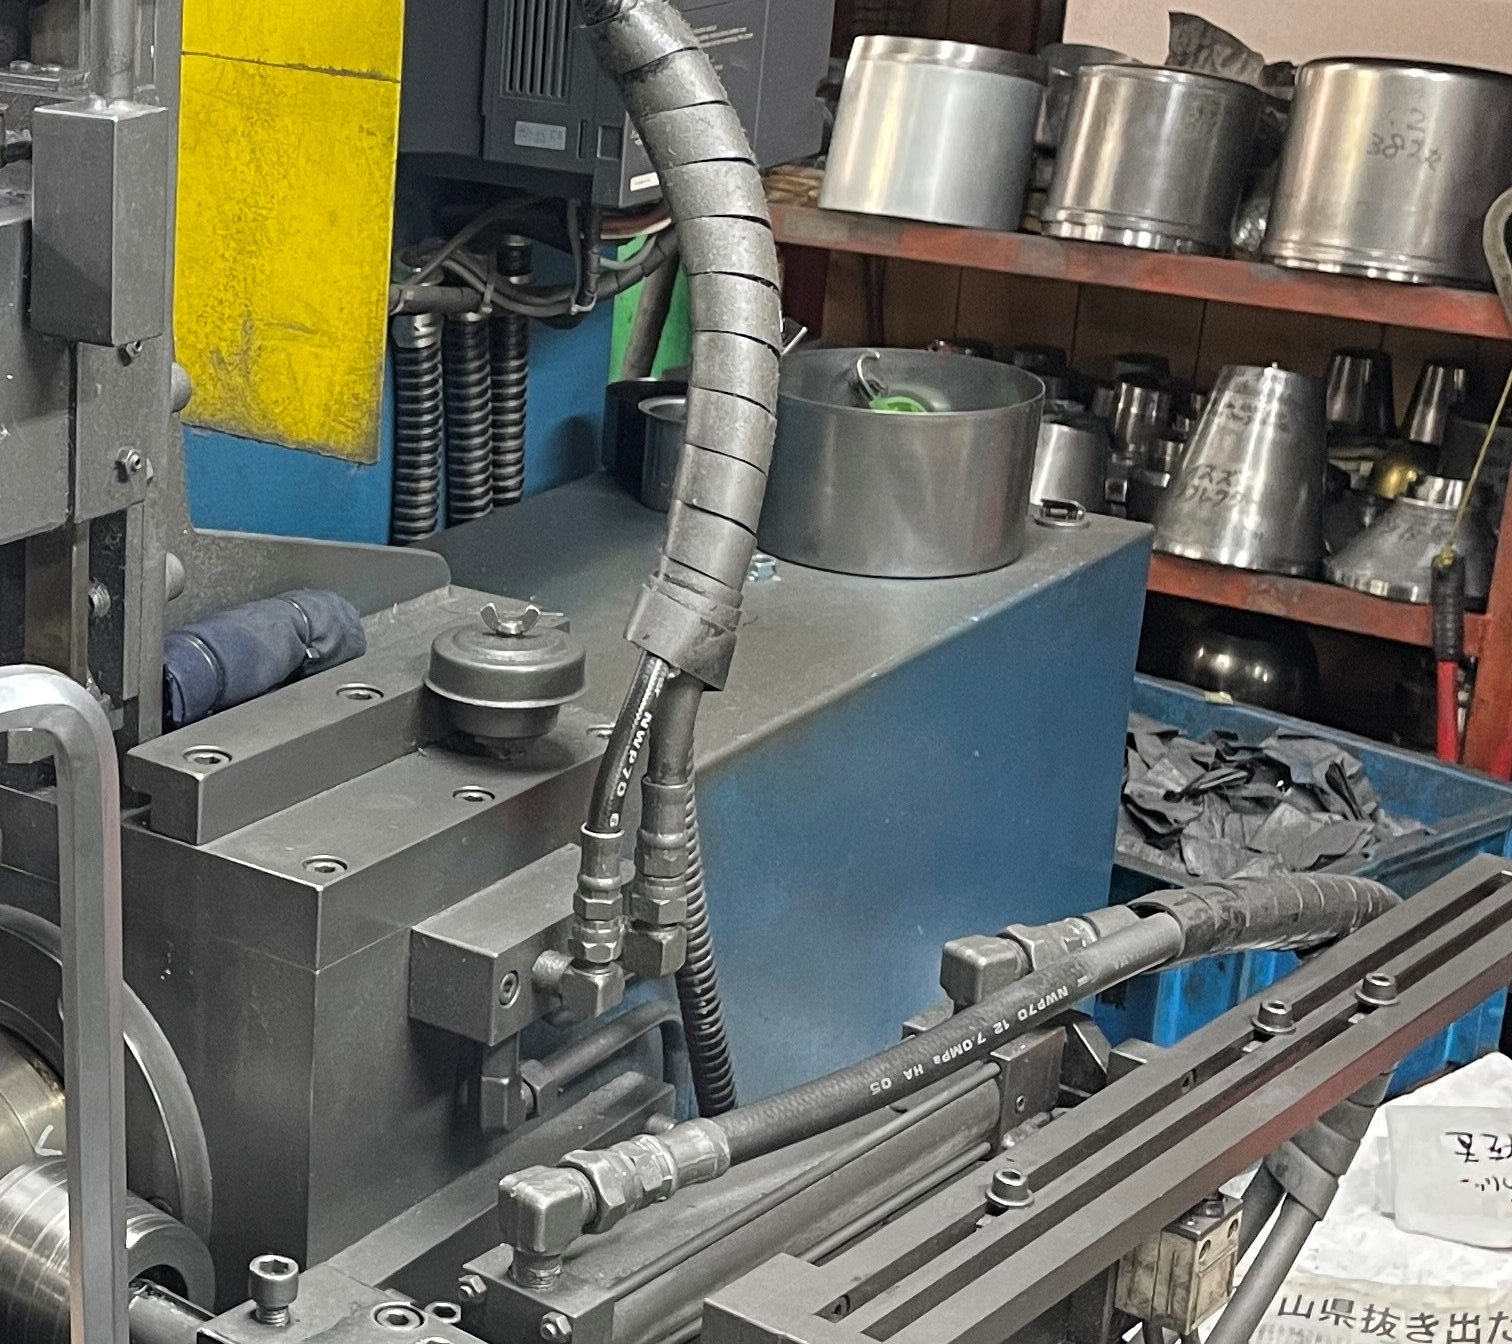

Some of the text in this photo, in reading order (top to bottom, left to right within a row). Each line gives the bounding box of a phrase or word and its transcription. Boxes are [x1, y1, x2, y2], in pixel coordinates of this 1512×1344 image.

[615, 711, 653, 797] NWP70
[1017, 985, 1069, 1022] NWP70
[992, 1018, 1010, 1035] 12
[933, 1032, 987, 1065] 7.0MPa
[902, 1063, 924, 1082] HA
